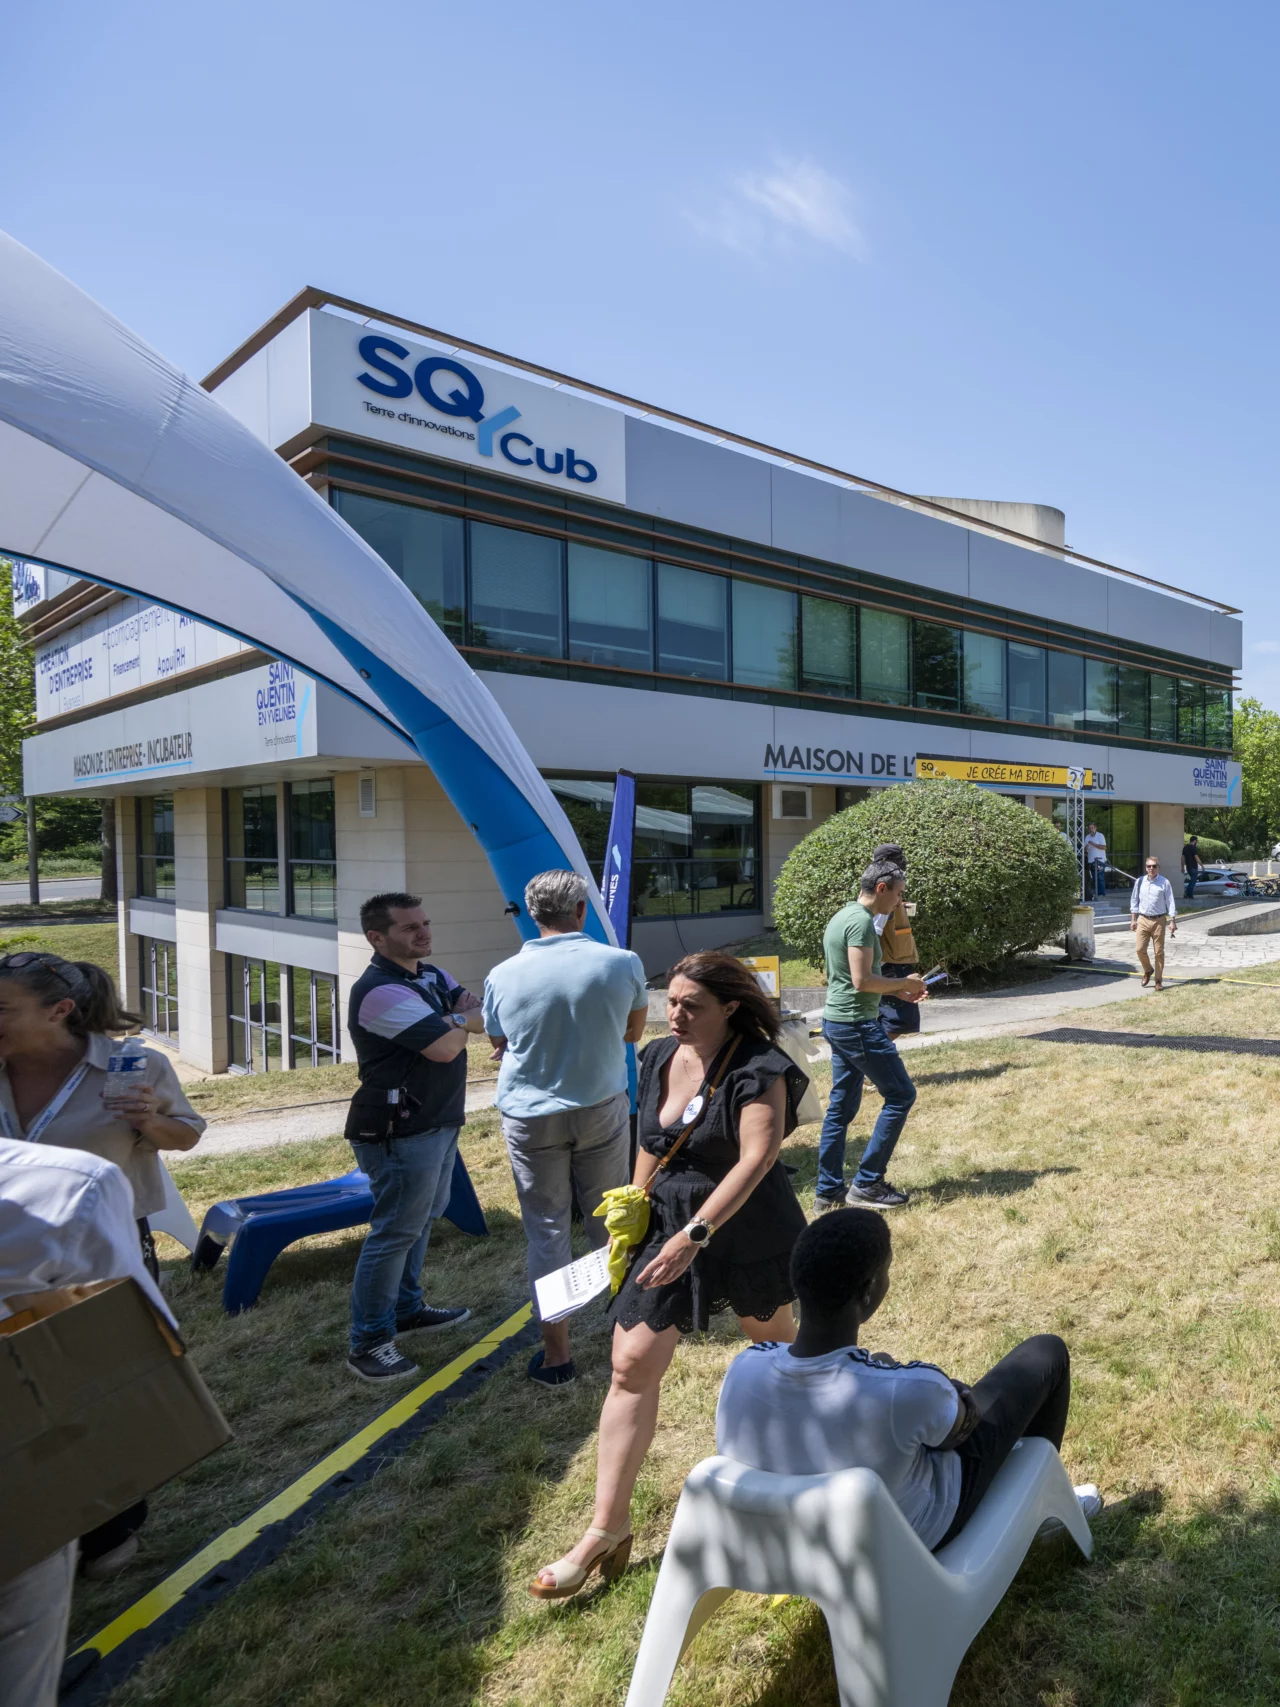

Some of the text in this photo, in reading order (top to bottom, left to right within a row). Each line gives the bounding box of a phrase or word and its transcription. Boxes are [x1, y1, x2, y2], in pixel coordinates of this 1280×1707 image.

[363, 401, 475, 441] Terre d'innovations
[500, 432, 598, 483] Cub
[102, 605, 170, 651] Accompagnement
[113, 654, 140, 677] Financement
[157, 646, 186, 676] Appui RH
[268, 663, 294, 685] SAINT
[50, 657, 93, 695] D'ENTREPRISE
[256, 681, 295, 710] QUENTIN
[258, 705, 295, 726] EN YVELINES
[73, 753, 95, 777] MAISON
[95, 752, 103, 773] DE
[104, 742, 143, 772] L'ENTREPRISE
[147, 732, 193, 765] INCUBATEUR
[264, 736, 274, 747] Terre
[763, 743, 863, 774] MAISON
[871, 753, 896, 776] DE
[967, 766, 978, 778] JE
[981, 765, 1006, 780] CRÉE
[1009, 769, 1022, 780] MA
[1205, 758, 1227, 770] SAINT
[1193, 768, 1227, 781] QUENTIN
[1202, 780, 1227, 788] YVELINES
